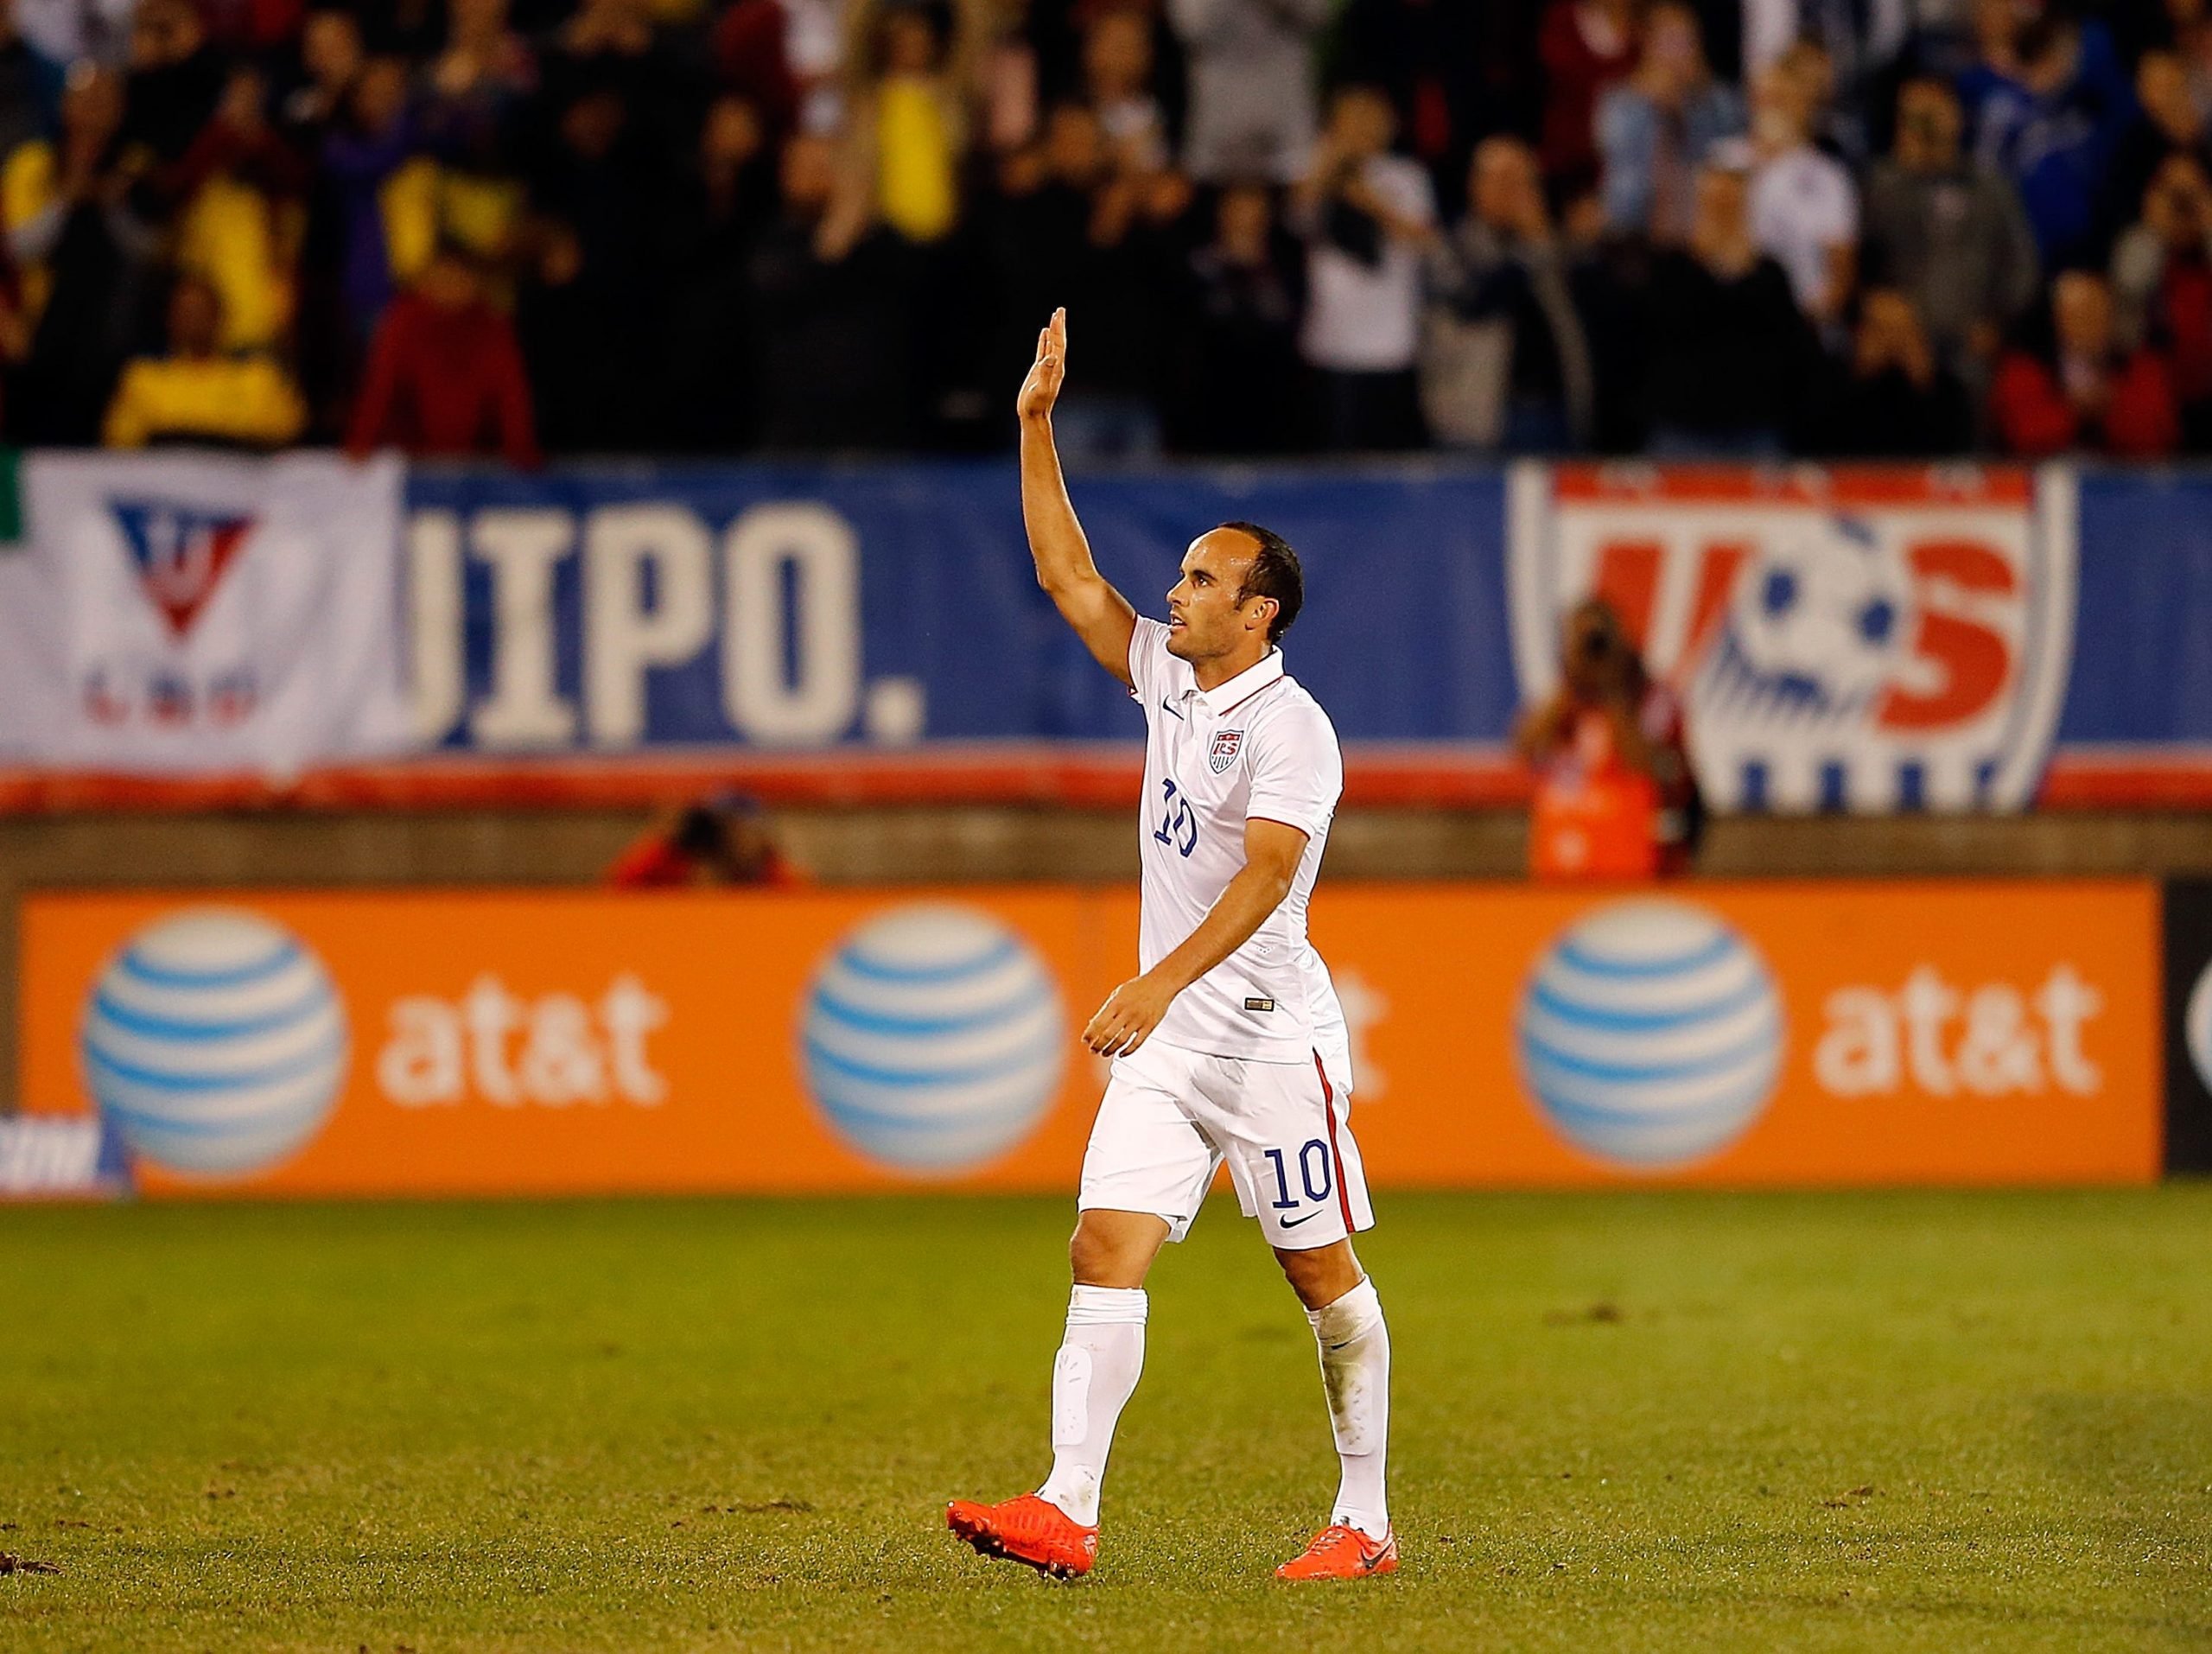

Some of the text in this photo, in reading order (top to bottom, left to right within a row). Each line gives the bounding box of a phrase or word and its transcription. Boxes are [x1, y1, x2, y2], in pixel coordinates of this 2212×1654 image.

[1154, 778, 1198, 858] 10
[375, 973, 669, 1108] at&t
[1815, 963, 2103, 1098] at&t
[1264, 1138, 1332, 1209] 10
